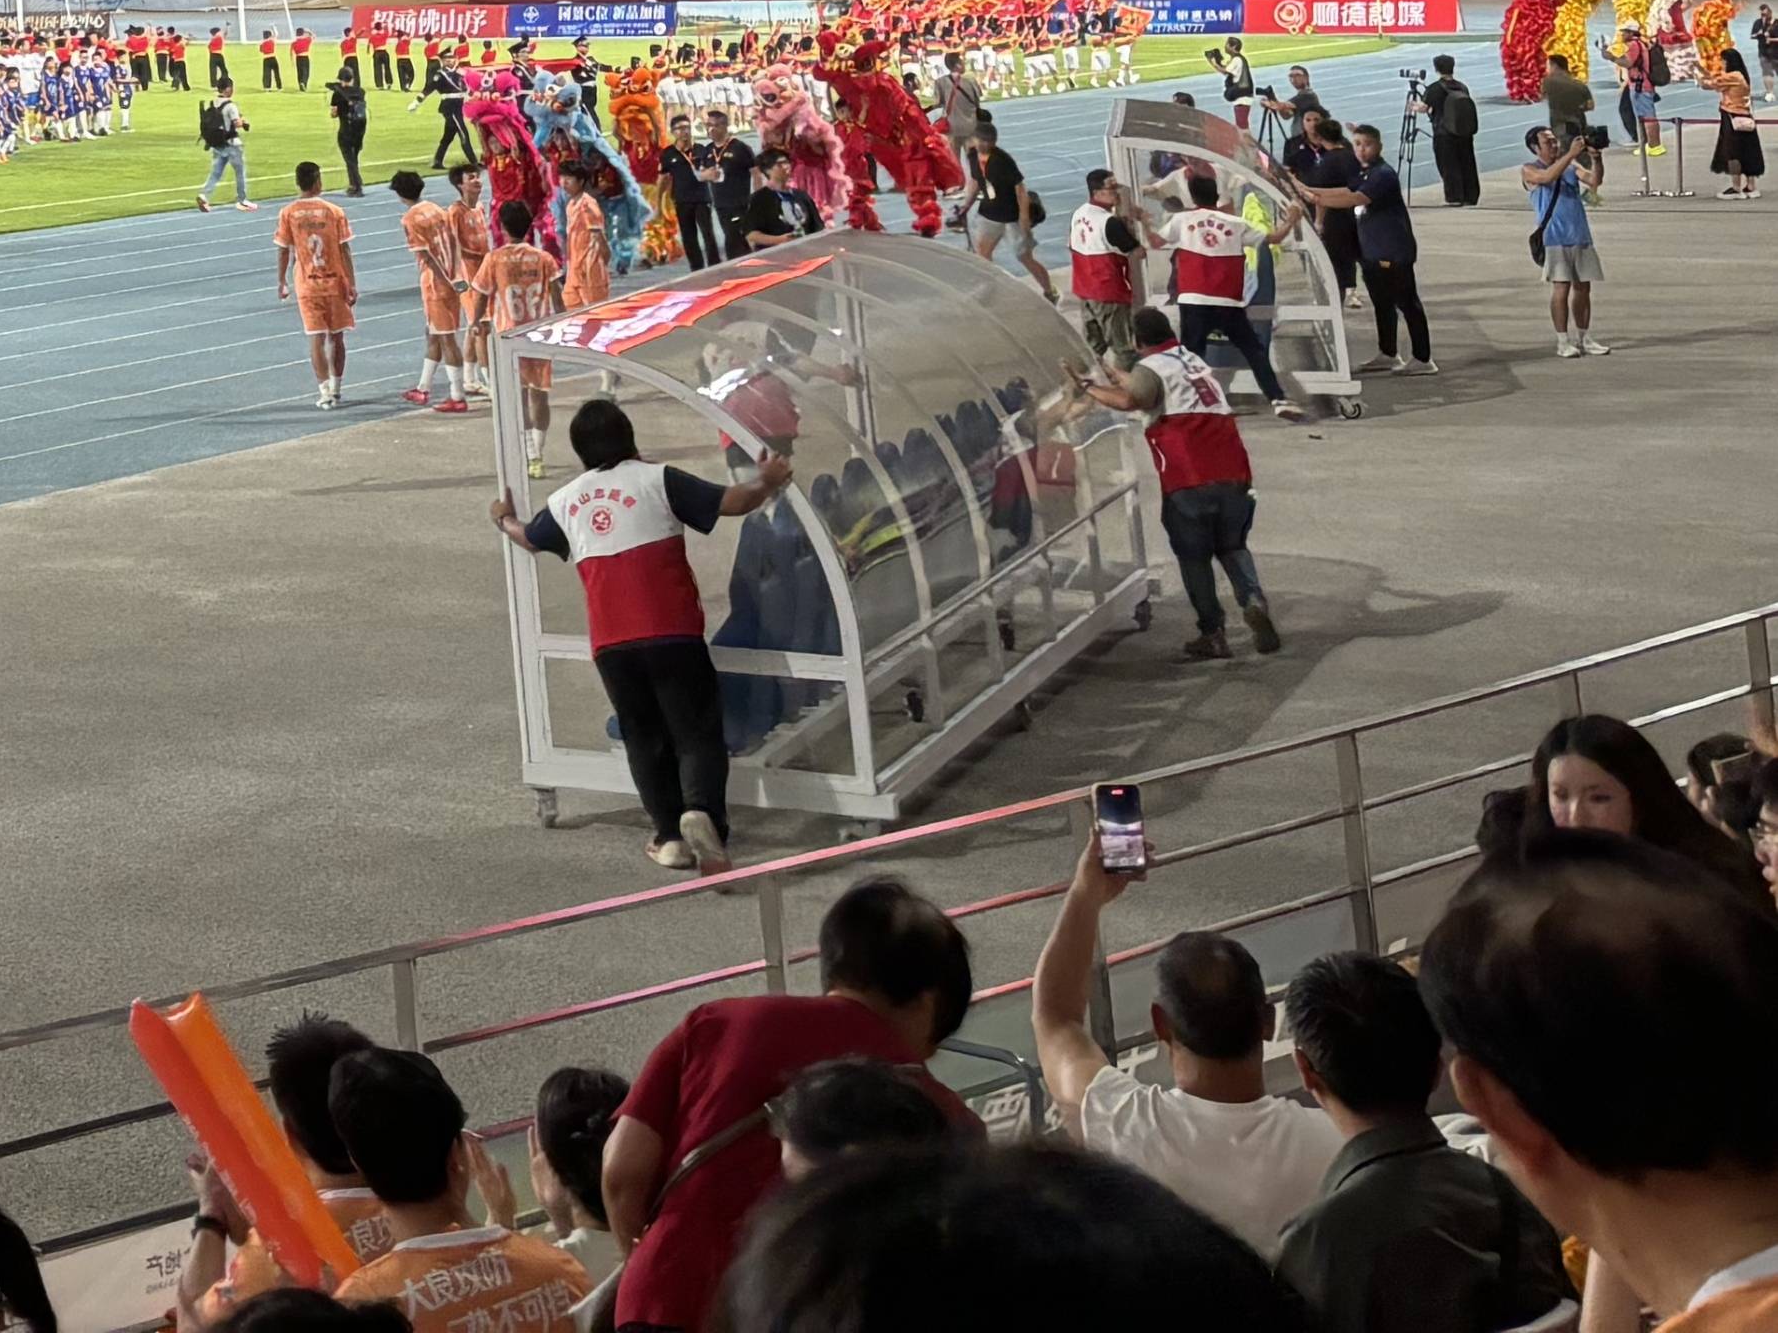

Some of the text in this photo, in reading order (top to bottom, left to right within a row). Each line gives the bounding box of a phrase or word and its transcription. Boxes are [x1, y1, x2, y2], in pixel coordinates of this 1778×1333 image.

[1312, 0, 1426, 27] 顺德融媒
[306, 234, 325, 267] 2
